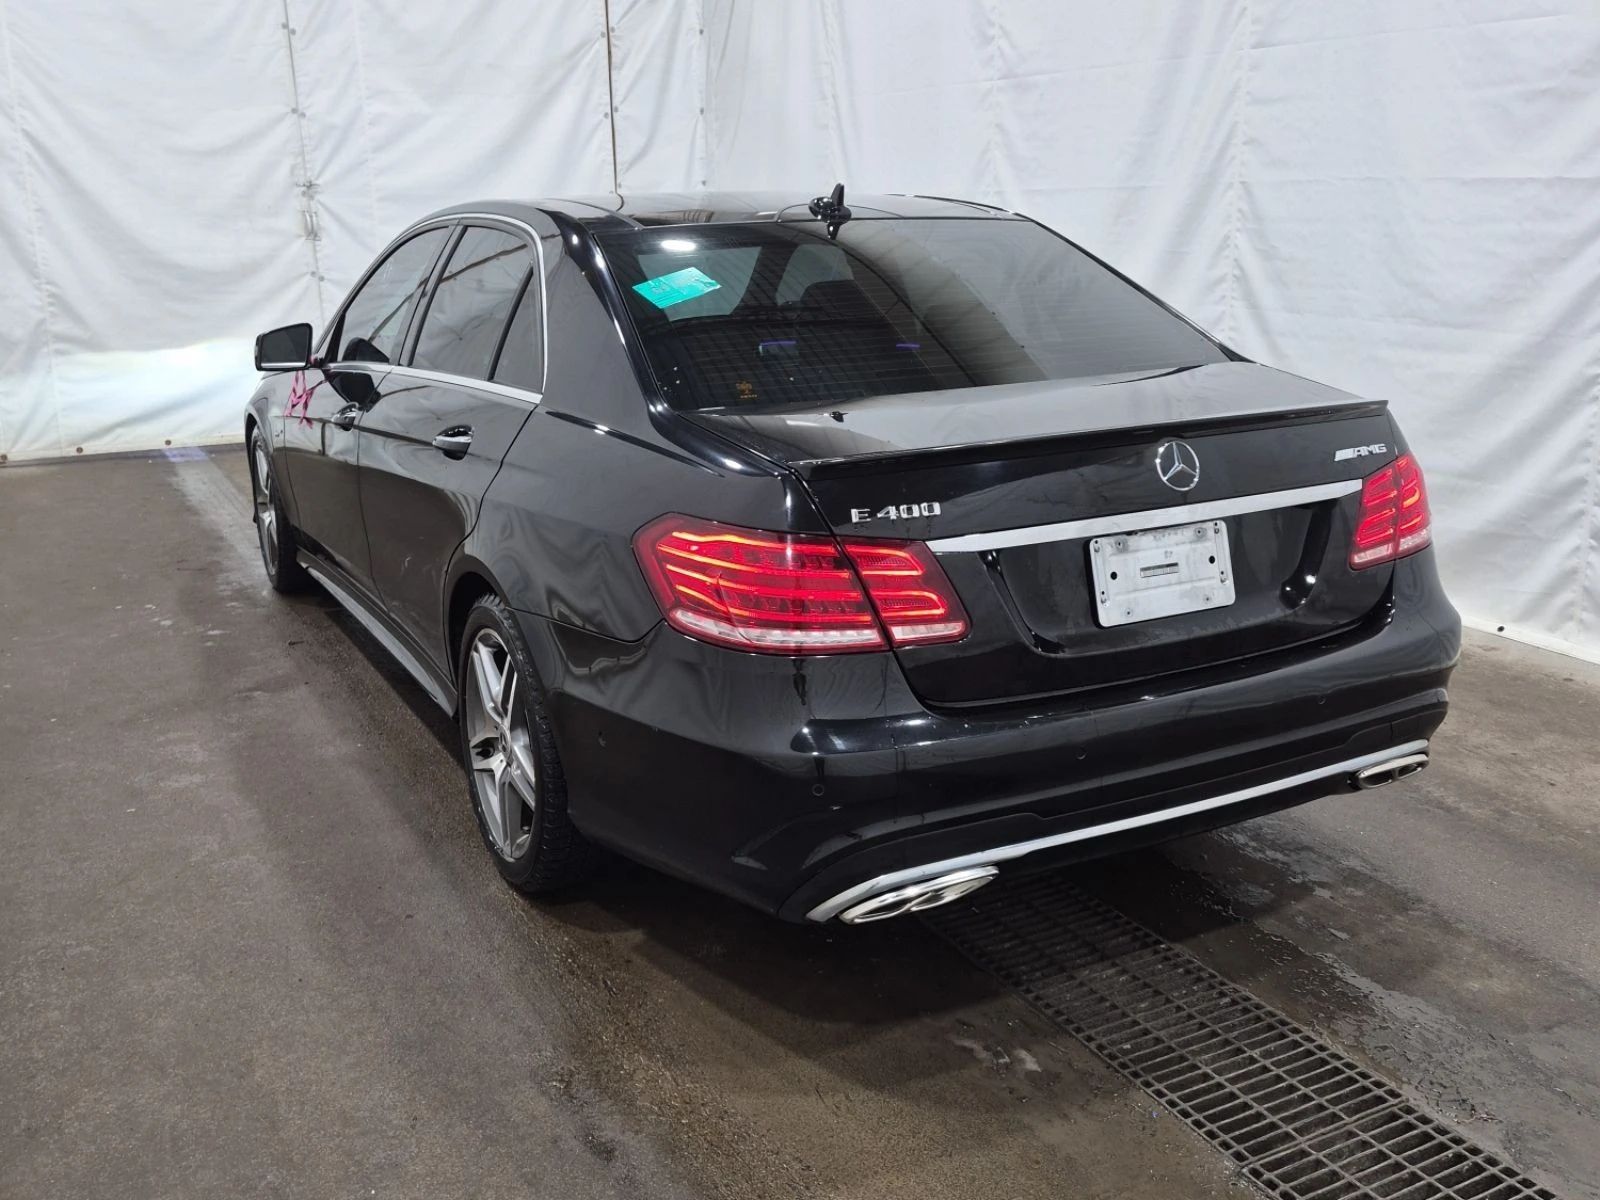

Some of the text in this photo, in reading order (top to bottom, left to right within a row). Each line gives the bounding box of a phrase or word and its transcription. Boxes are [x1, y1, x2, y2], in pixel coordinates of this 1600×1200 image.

[1352, 443, 1387, 458] AMG
[851, 502, 941, 523] E 400
